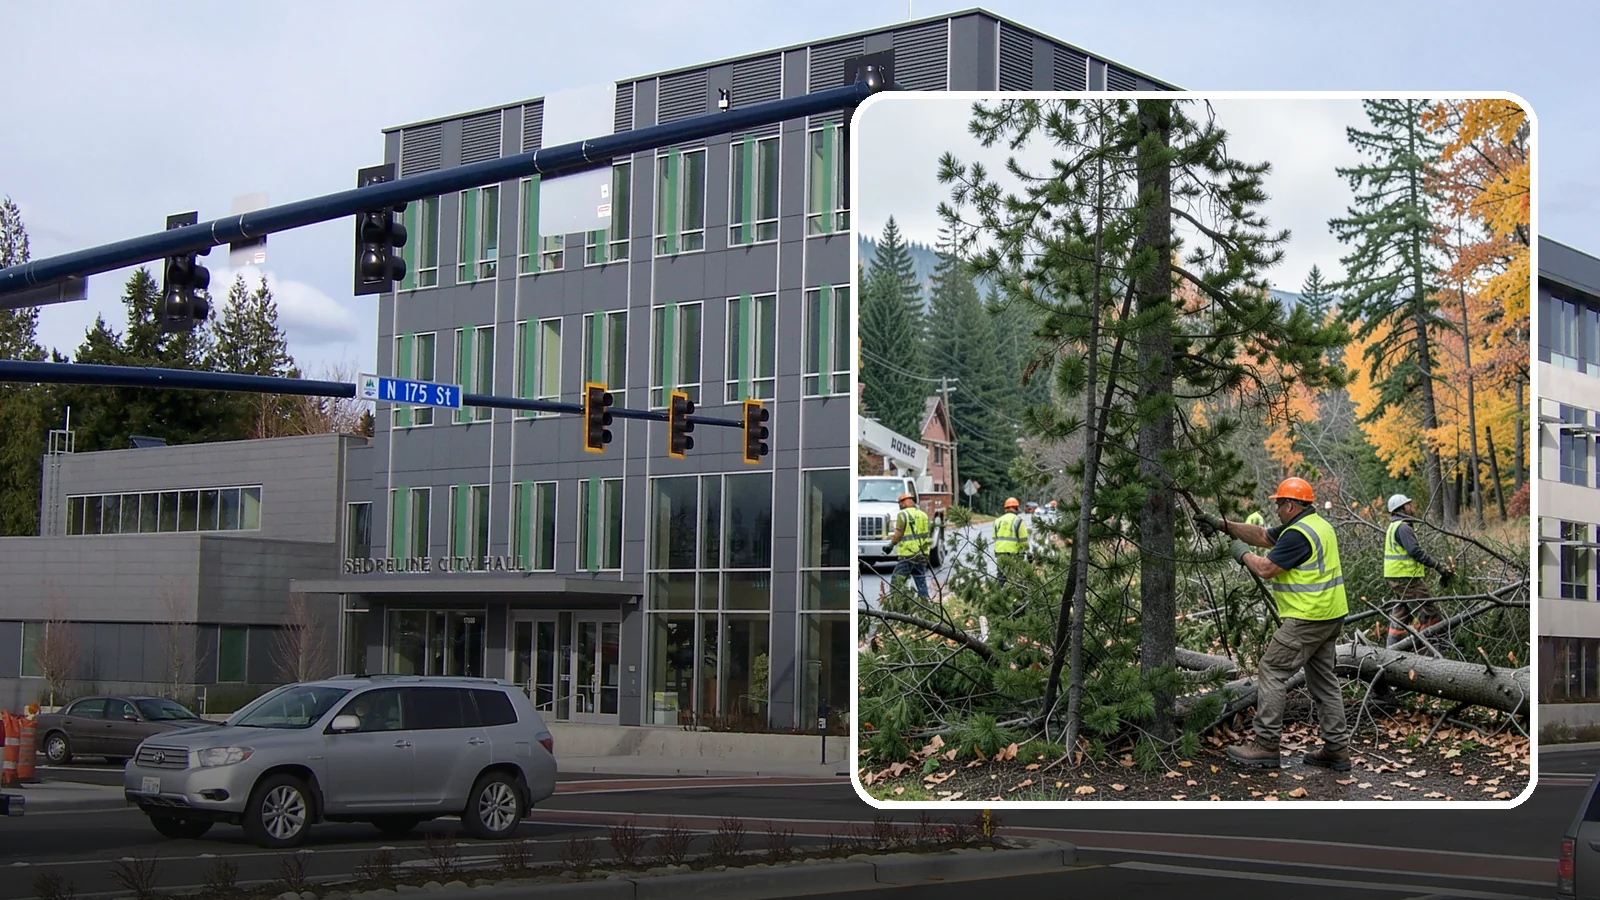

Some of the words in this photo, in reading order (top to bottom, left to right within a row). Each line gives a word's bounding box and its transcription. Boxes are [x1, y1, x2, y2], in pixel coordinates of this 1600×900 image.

[387, 380, 396, 399] N
[405, 383, 427, 403] 175
[436, 387, 451, 405] St
[344, 557, 432, 574] SHORELINE
[438, 556, 476, 572] CITY
[482, 555, 526, 572] HALL
